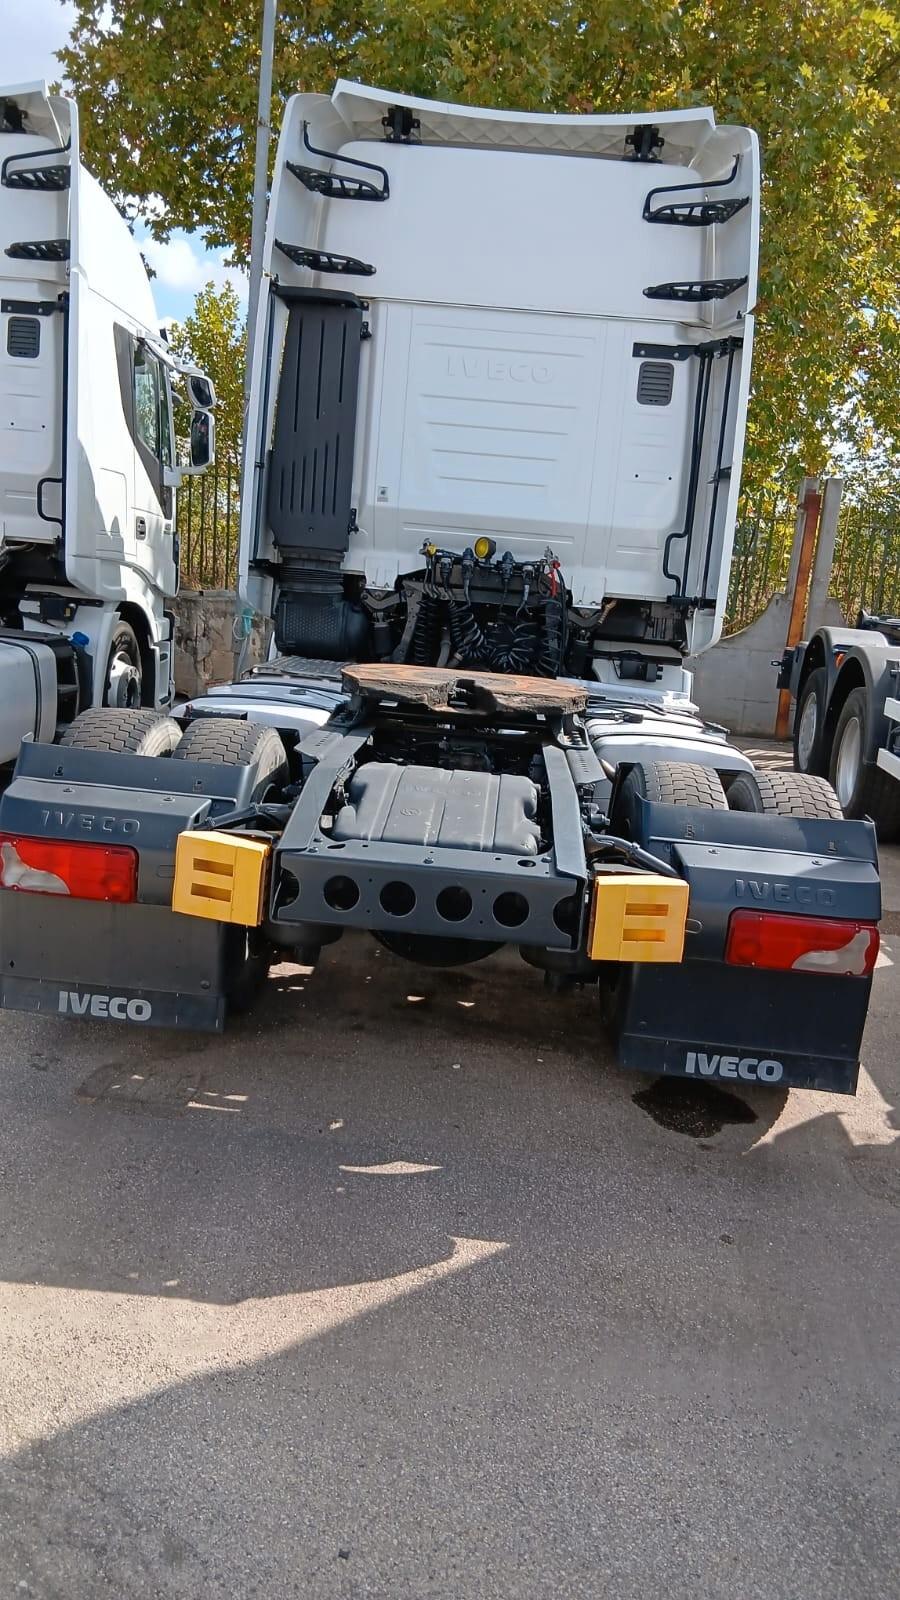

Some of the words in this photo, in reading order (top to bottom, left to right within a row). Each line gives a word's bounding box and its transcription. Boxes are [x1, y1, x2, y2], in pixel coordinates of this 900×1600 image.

[446, 352, 552, 384] IVECO
[41, 809, 141, 833] IVECO
[735, 879, 837, 906] IVECO
[58, 990, 152, 1021] IVECO
[685, 1052, 783, 1082] IVECO
